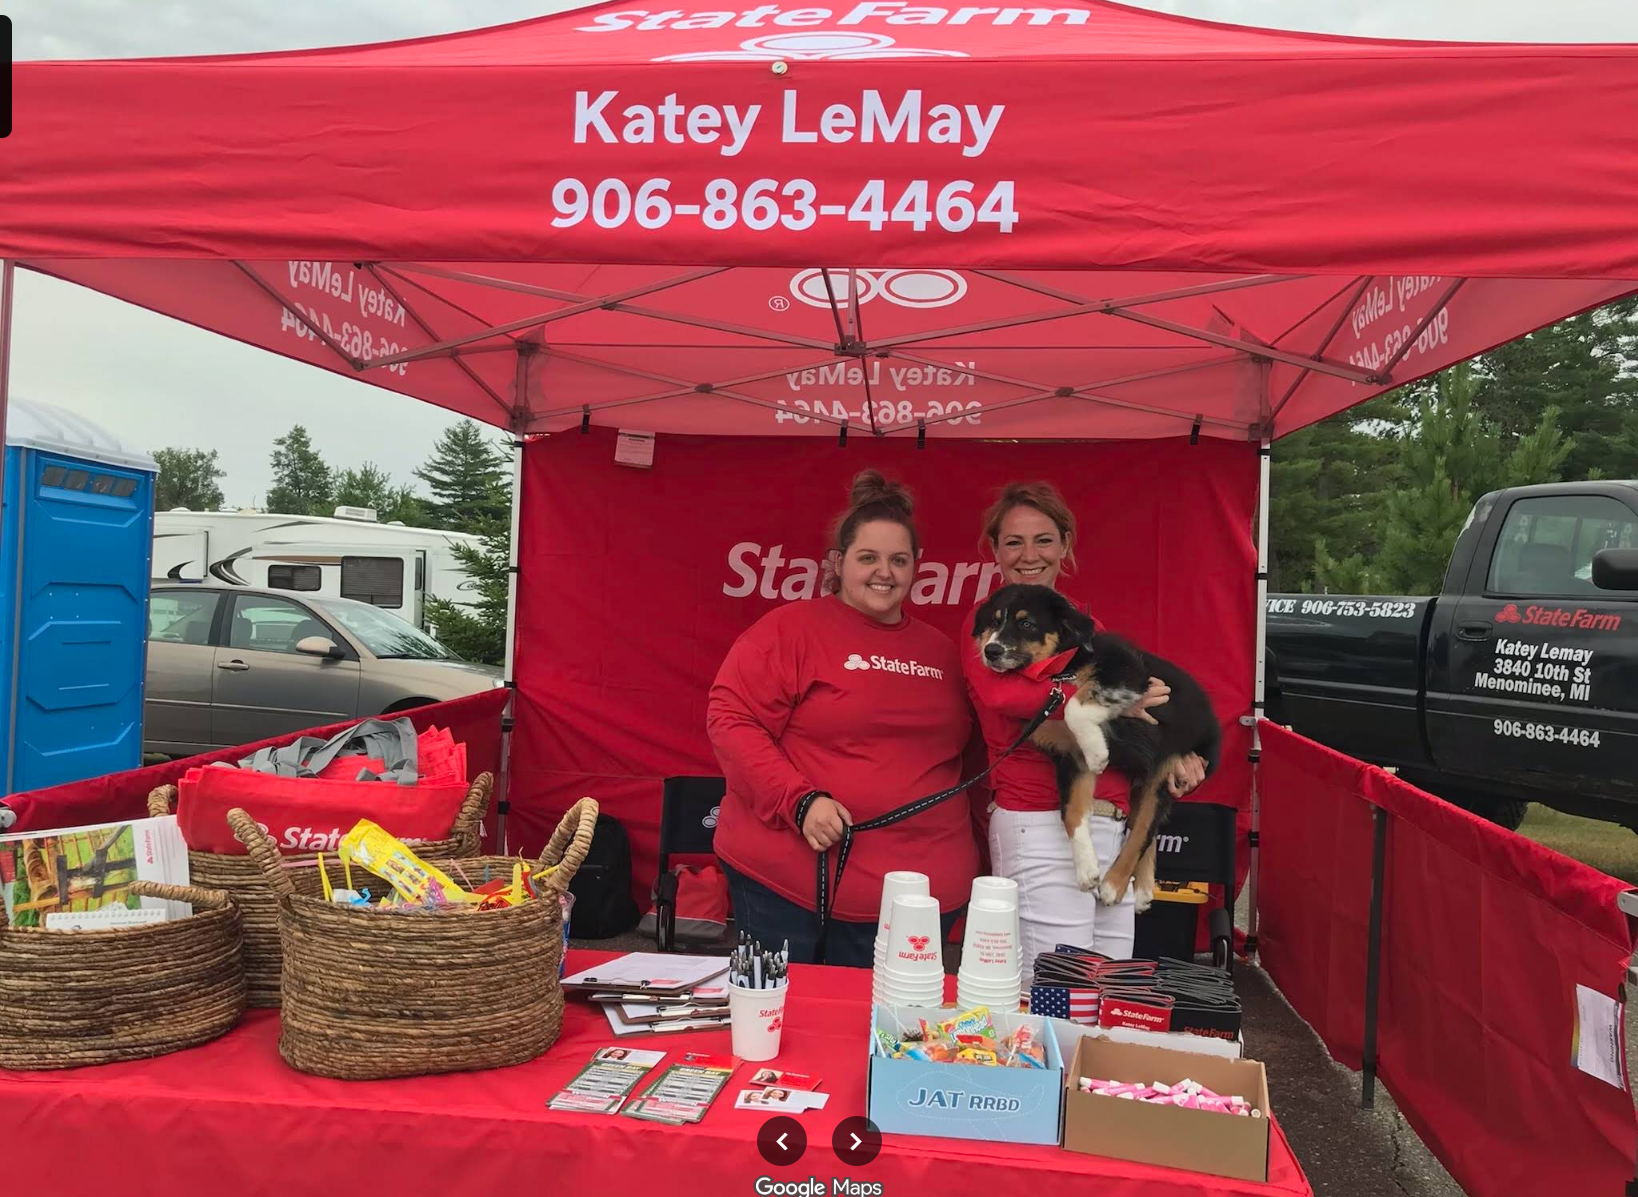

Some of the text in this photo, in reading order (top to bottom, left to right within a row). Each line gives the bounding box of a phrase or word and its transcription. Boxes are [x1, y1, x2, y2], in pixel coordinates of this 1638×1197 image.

[573, 89, 1005, 157] Katey LeMay
[550, 178, 1019, 233] 906-863-4464
[1301, 600, 1416, 618] 906-753-5823
[1495, 639, 1594, 666] Katey Lemay
[1493, 658, 1591, 684] 3840 10th St
[1474, 672, 1591, 701] Menominee, MI
[1494, 719, 1600, 748] 906-863-4464
[909, 1088, 1021, 1112] JAT RRBD
